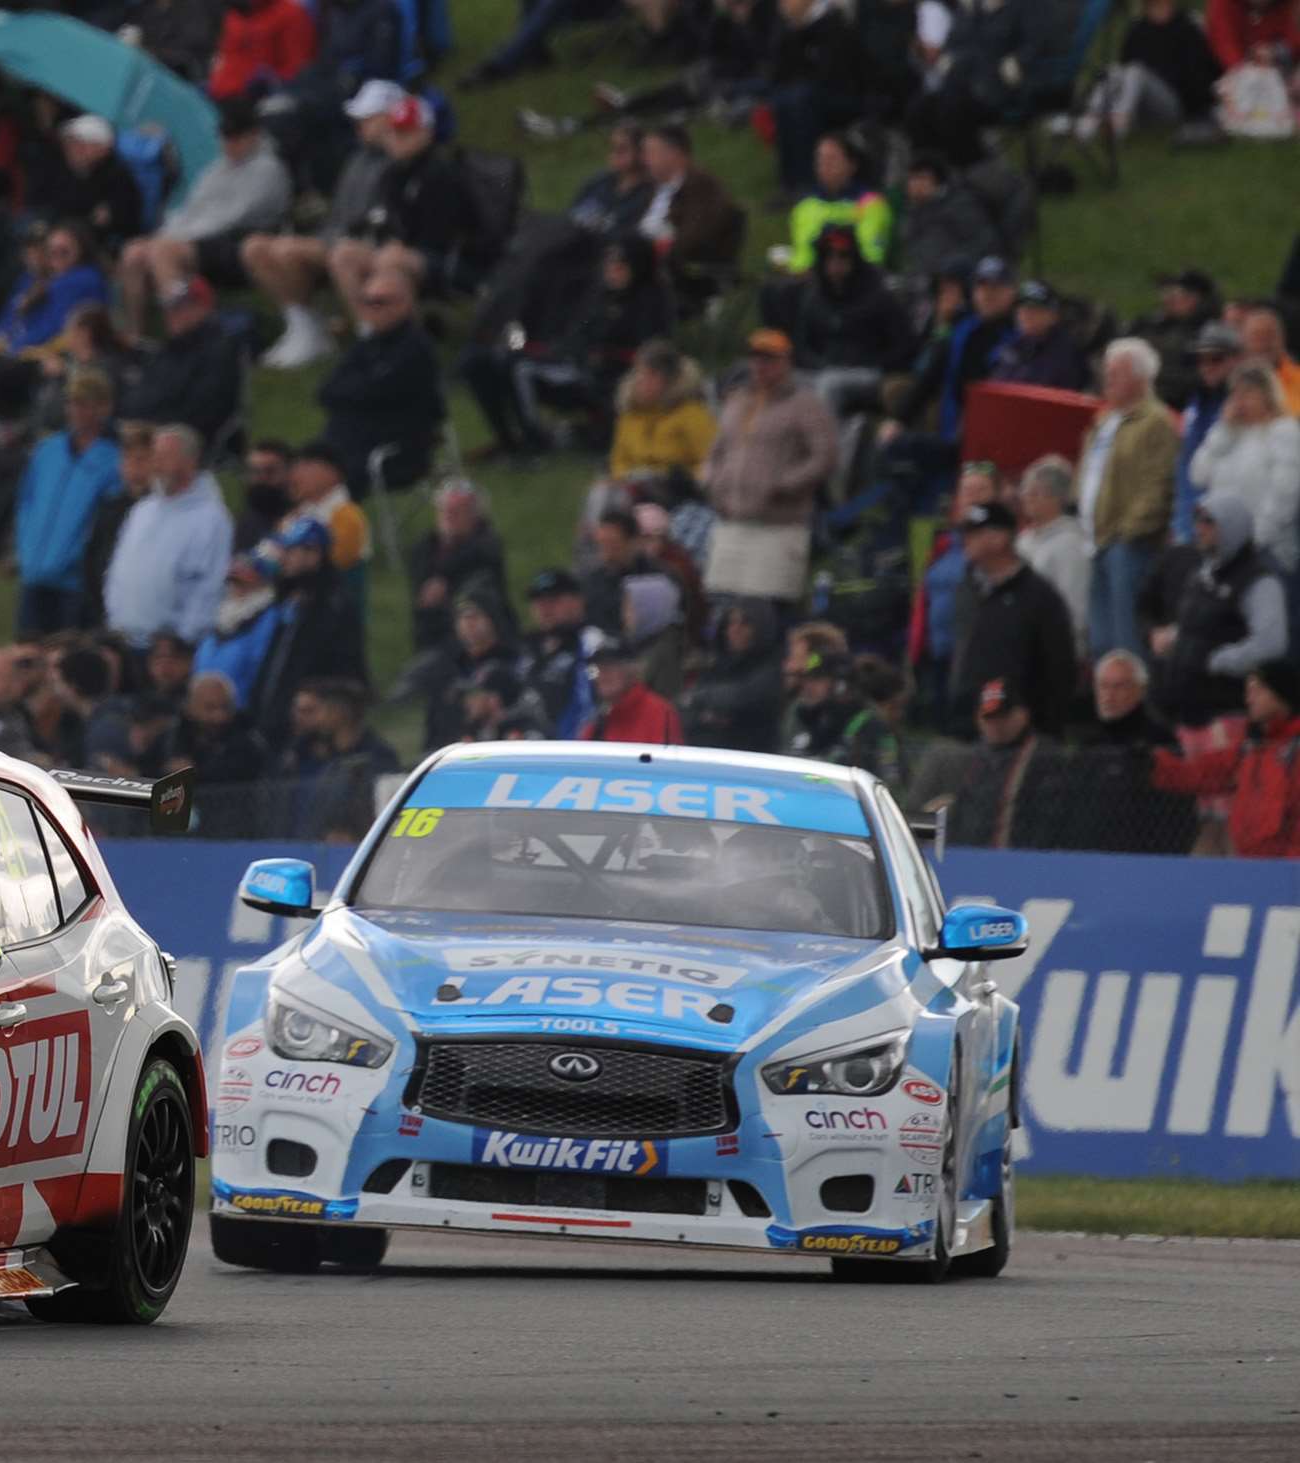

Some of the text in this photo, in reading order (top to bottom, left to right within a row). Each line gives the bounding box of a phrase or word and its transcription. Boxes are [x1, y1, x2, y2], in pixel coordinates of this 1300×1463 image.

[484, 773, 783, 825] LASER
[391, 807, 444, 838] 16
[469, 951, 721, 984] SYNETIQ
[430, 975, 719, 1020] LASER
[538, 1016, 620, 1035] TOOLS
[265, 1070, 341, 1095] cinch
[805, 1107, 887, 1130] cinch
[232, 1195, 323, 1215] GOODYEAR
[802, 1234, 899, 1253] GOODYEAR
